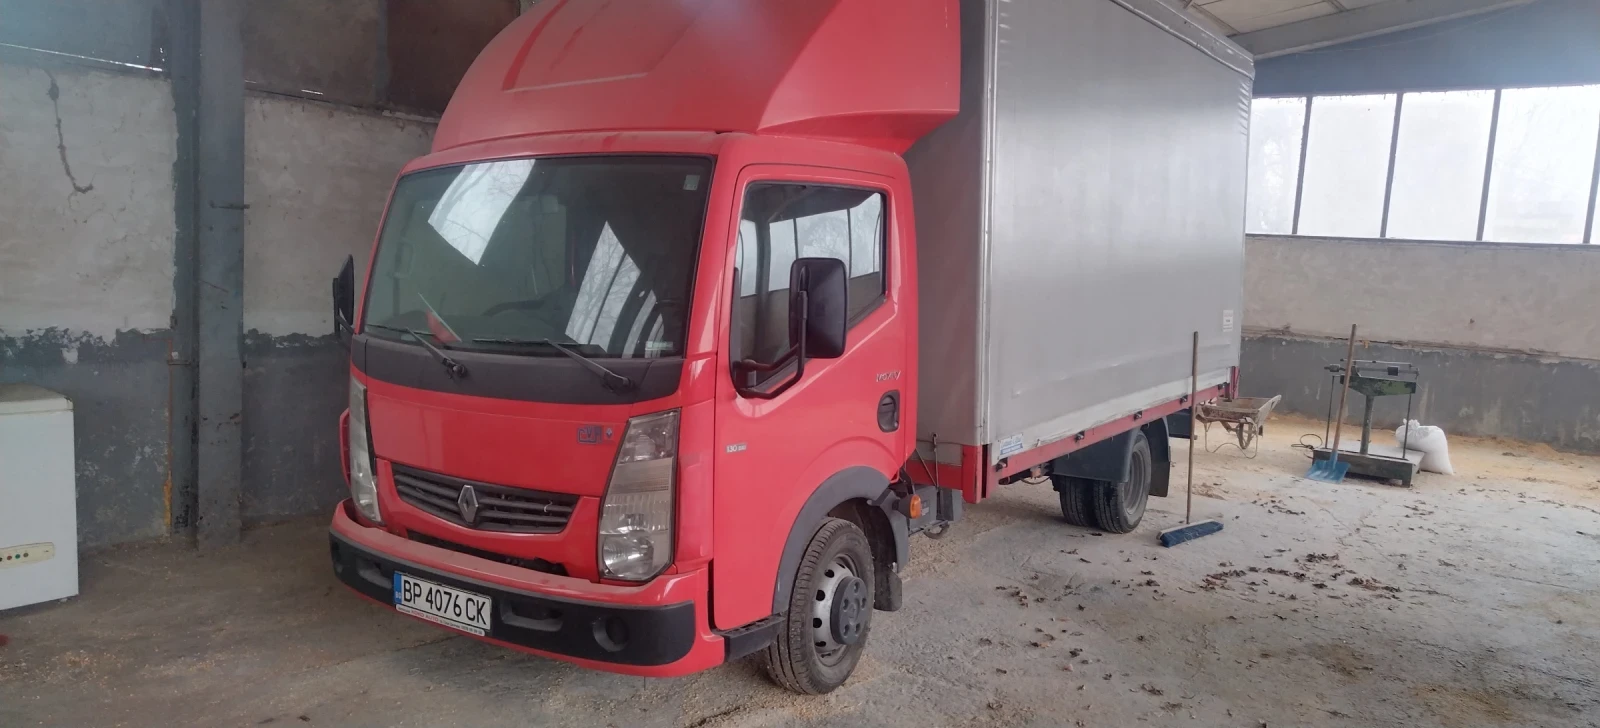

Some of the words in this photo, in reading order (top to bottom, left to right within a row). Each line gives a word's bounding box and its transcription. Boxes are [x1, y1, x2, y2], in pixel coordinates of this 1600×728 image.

[403, 580, 422, 604] BP
[425, 587, 462, 617] 4076
[466, 598, 486, 625] CK
